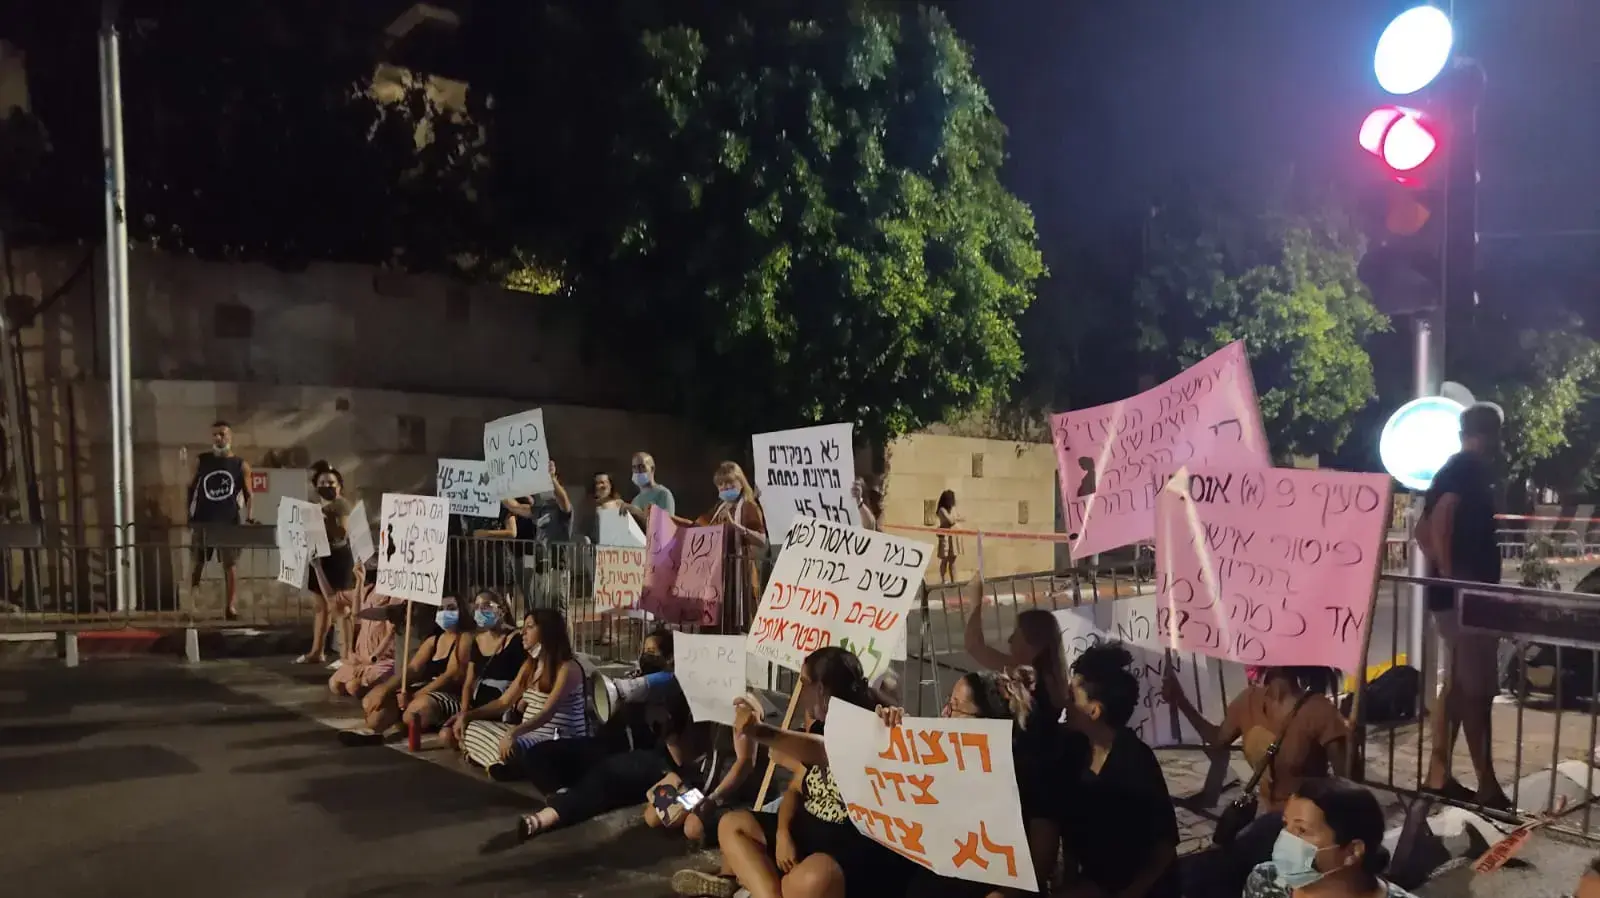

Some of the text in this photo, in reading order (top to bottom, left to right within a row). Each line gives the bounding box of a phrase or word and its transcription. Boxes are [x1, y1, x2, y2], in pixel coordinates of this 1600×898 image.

[820, 437, 840, 465] לא
[438, 465, 454, 490] 45
[1276, 477, 1297, 509] 9
[794, 497, 817, 519] 45
[1311, 481, 1380, 529] סעיף
[400, 538, 416, 565] 45
[818, 524, 872, 556] שאסור
[883, 542, 923, 568] כמו
[1270, 535, 1363, 567] פיטורי
[623, 550, 645, 568] שים
[606, 570, 644, 585] ורשות
[796, 557, 908, 599] נשים בהריון
[1218, 556, 1298, 600] בהריון
[770, 582, 899, 631] שגם המדינה
[878, 726, 993, 773] רוצות
[864, 766, 940, 807] צדק
[952, 820, 1018, 878] לא
